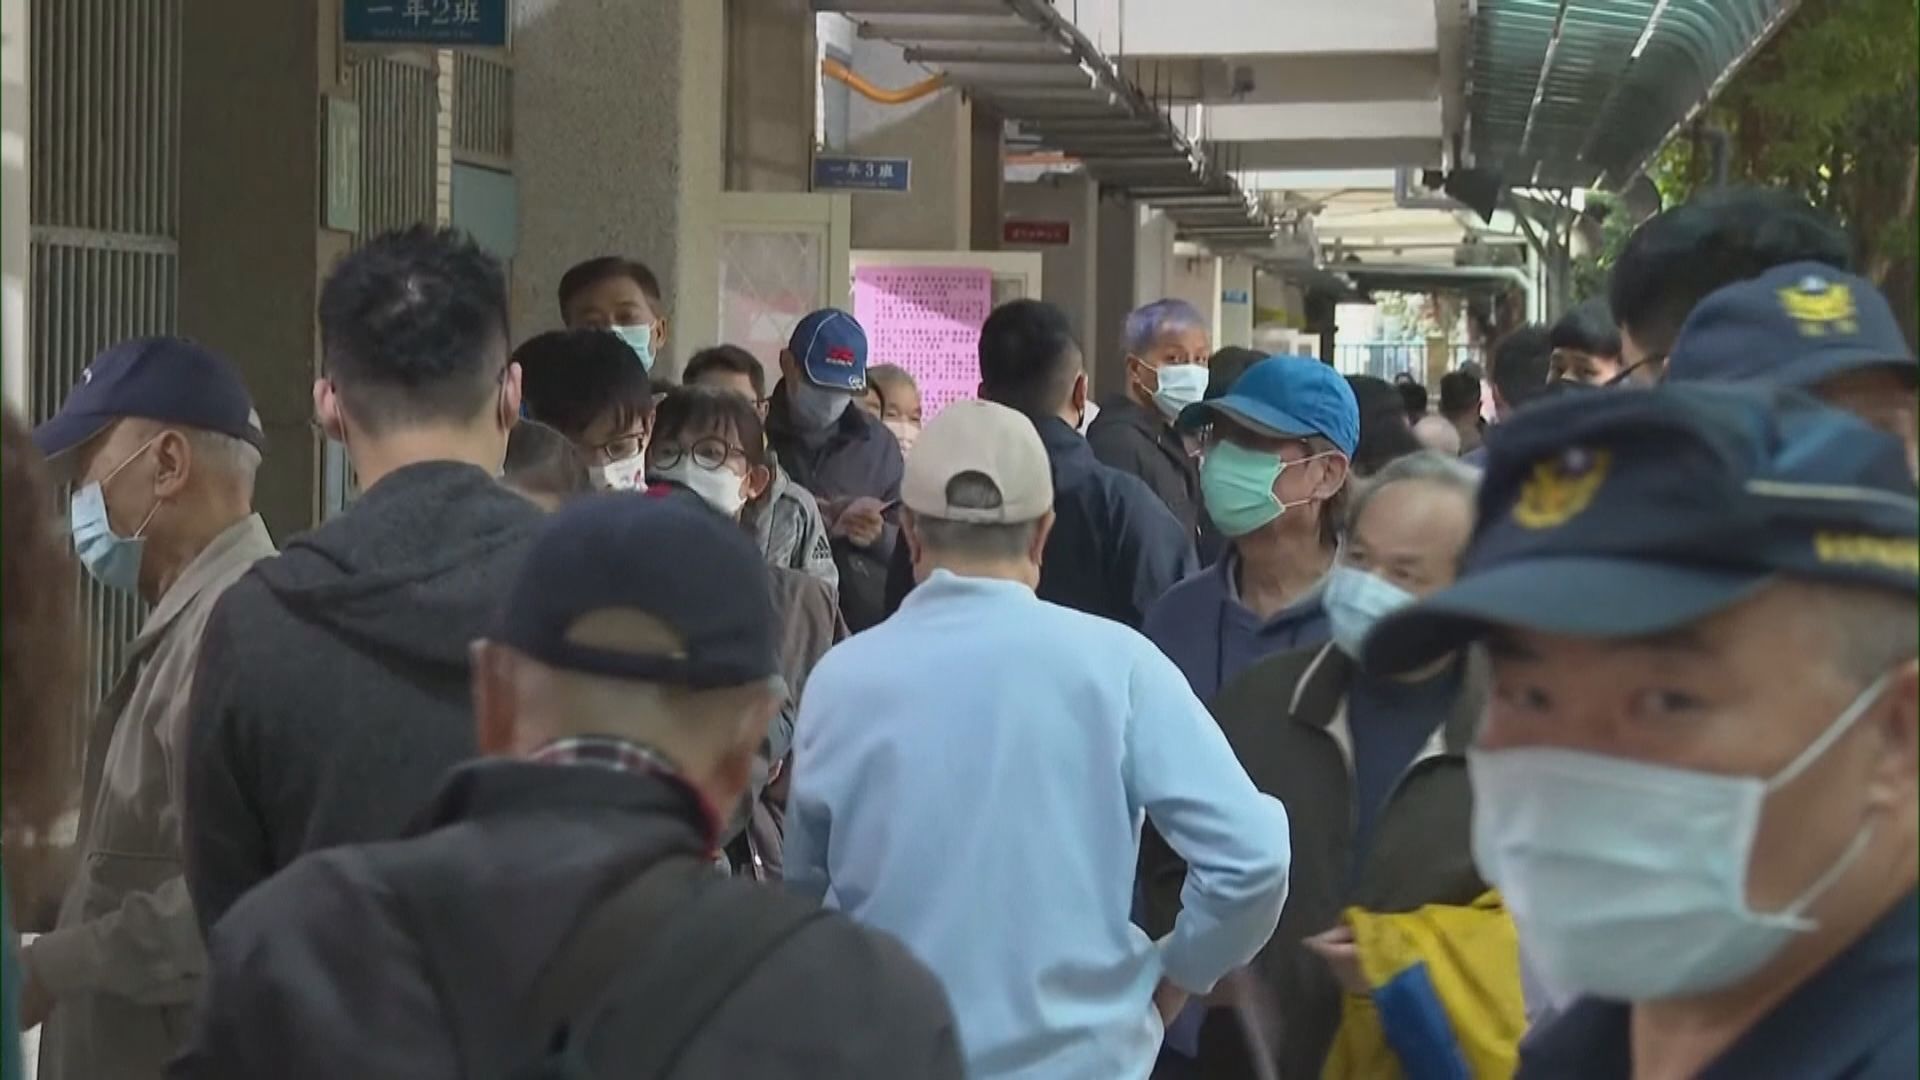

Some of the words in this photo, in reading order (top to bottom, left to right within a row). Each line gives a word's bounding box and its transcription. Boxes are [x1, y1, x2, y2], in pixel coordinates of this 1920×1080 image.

[367, 0, 481, 27] 一年2班
[829, 161, 895, 178] 一年3班
